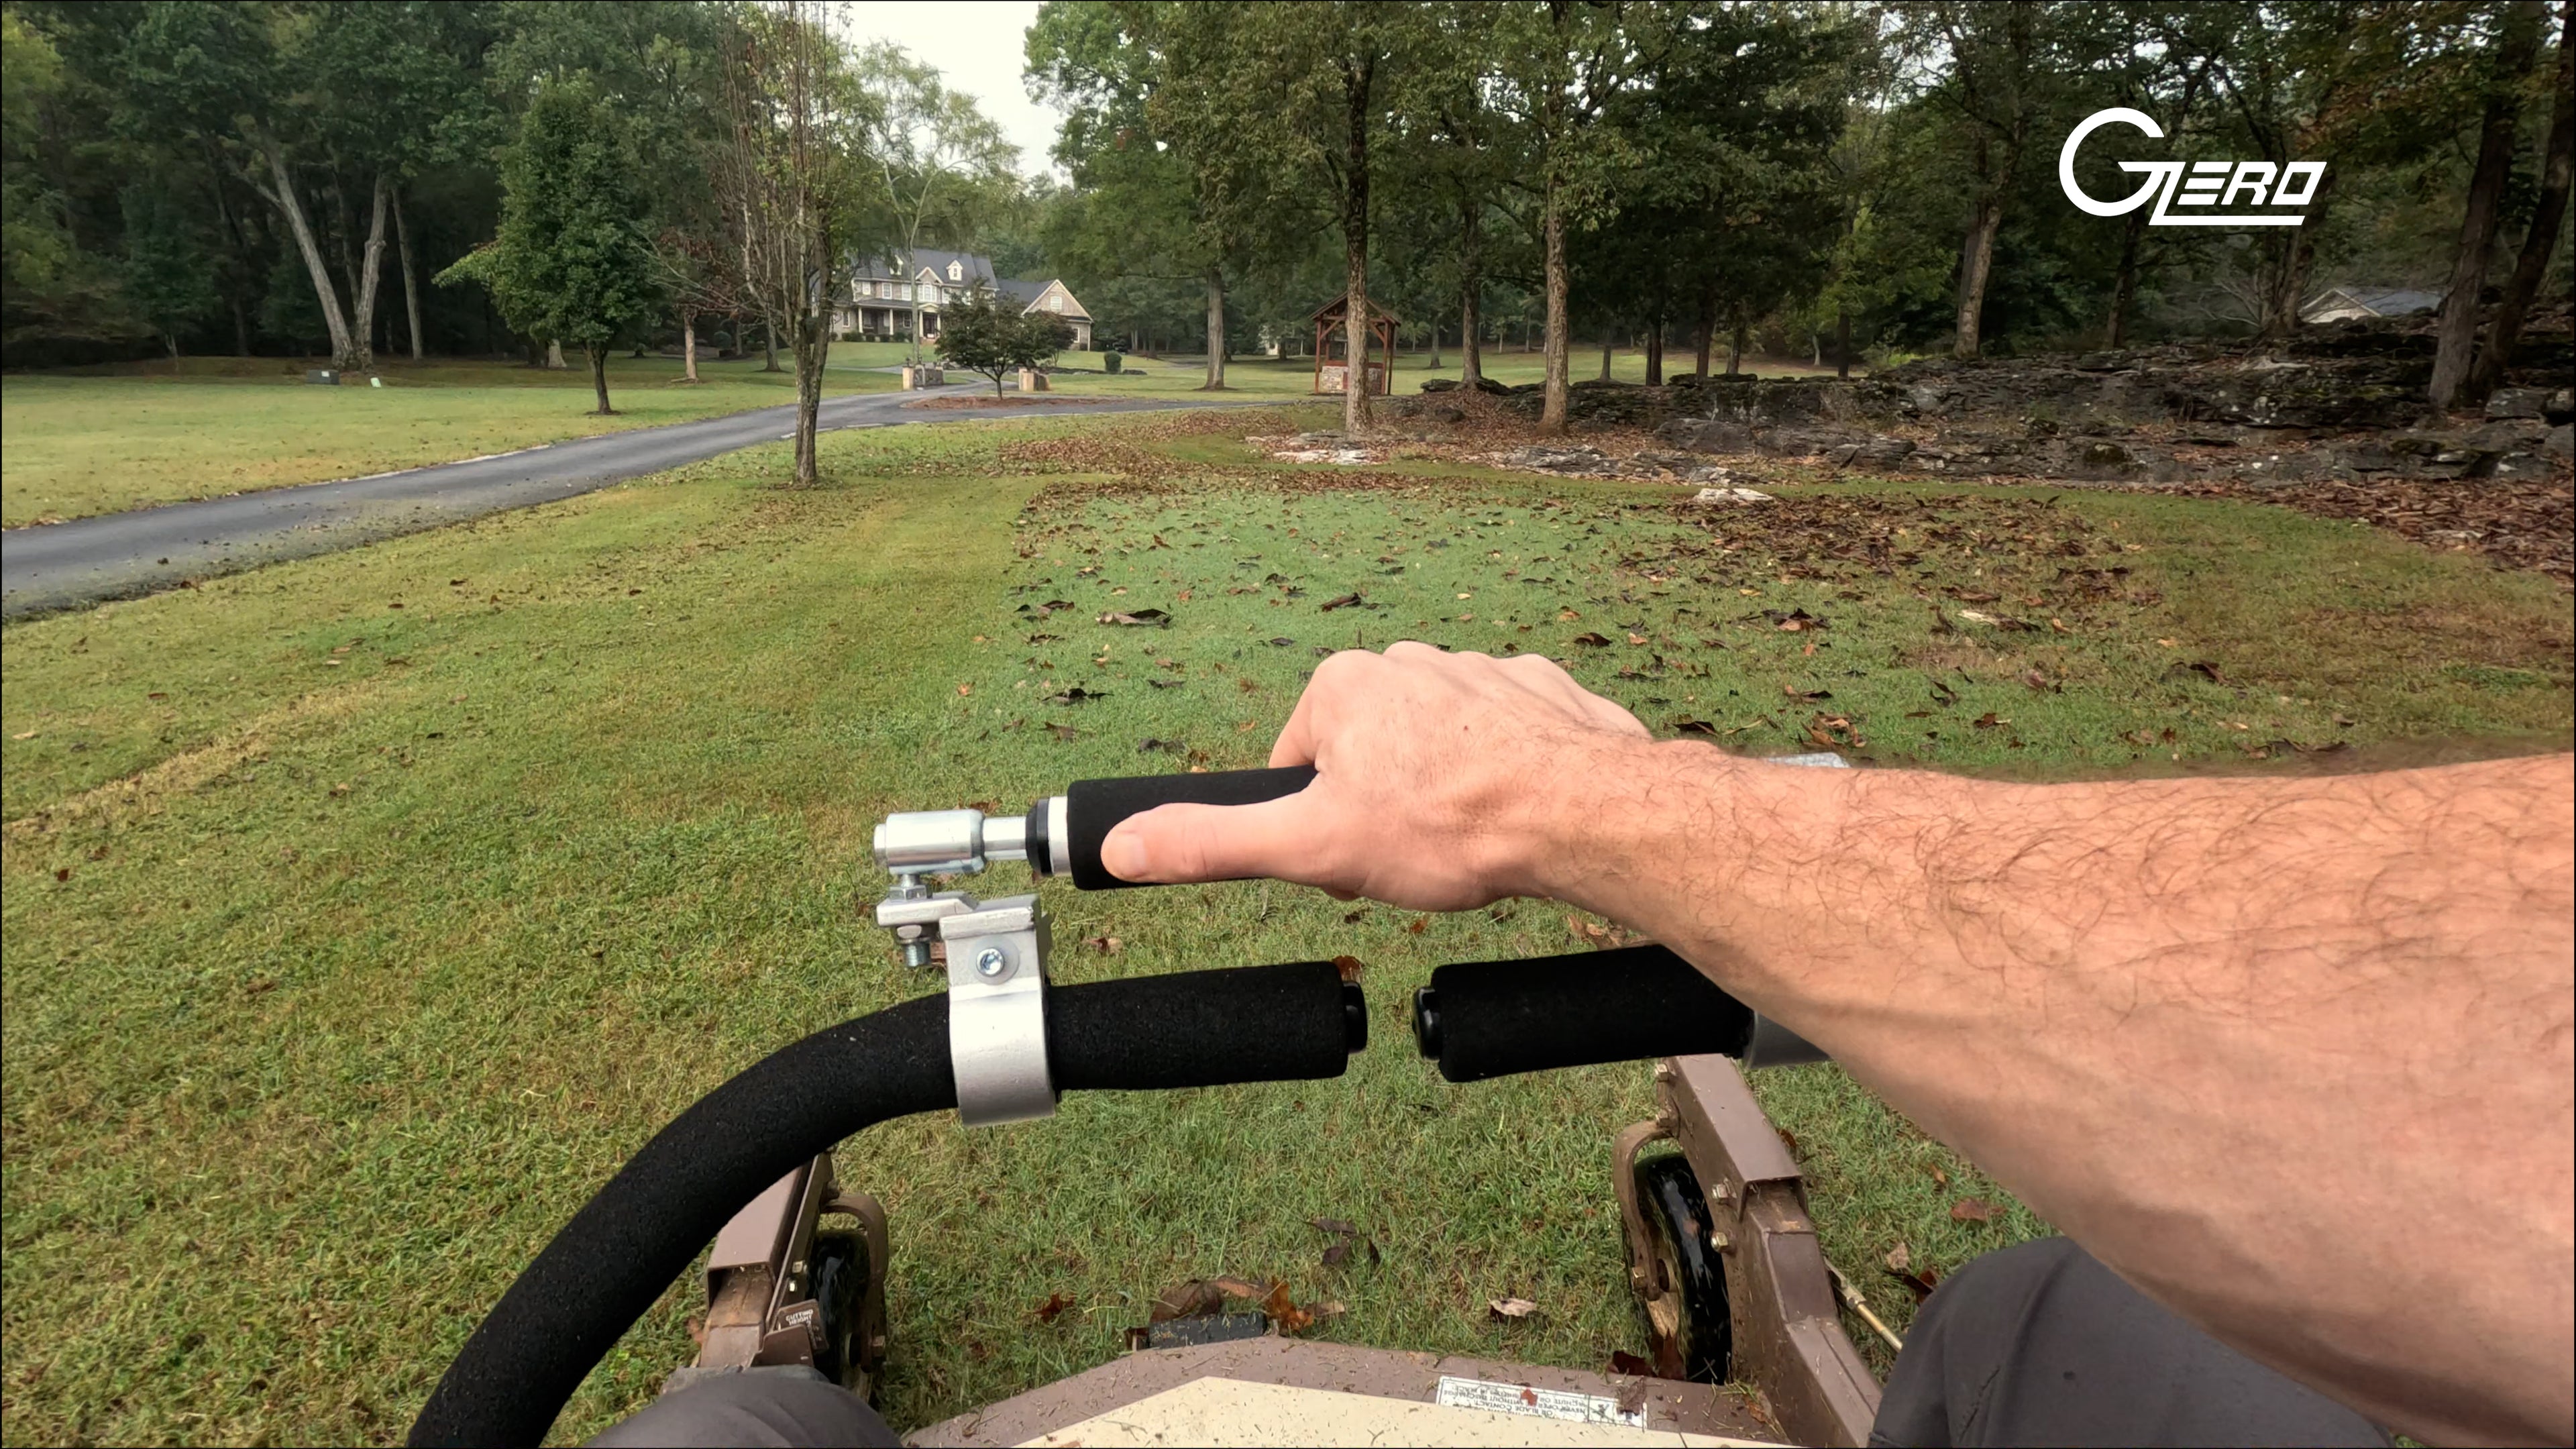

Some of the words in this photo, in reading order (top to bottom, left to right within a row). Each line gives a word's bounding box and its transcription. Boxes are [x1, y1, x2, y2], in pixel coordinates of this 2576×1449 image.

[786, 1309, 813, 1321] CUTTING
[789, 1315, 812, 1326] HEIGHT
[1514, 1405, 1539, 1414] BLADE
